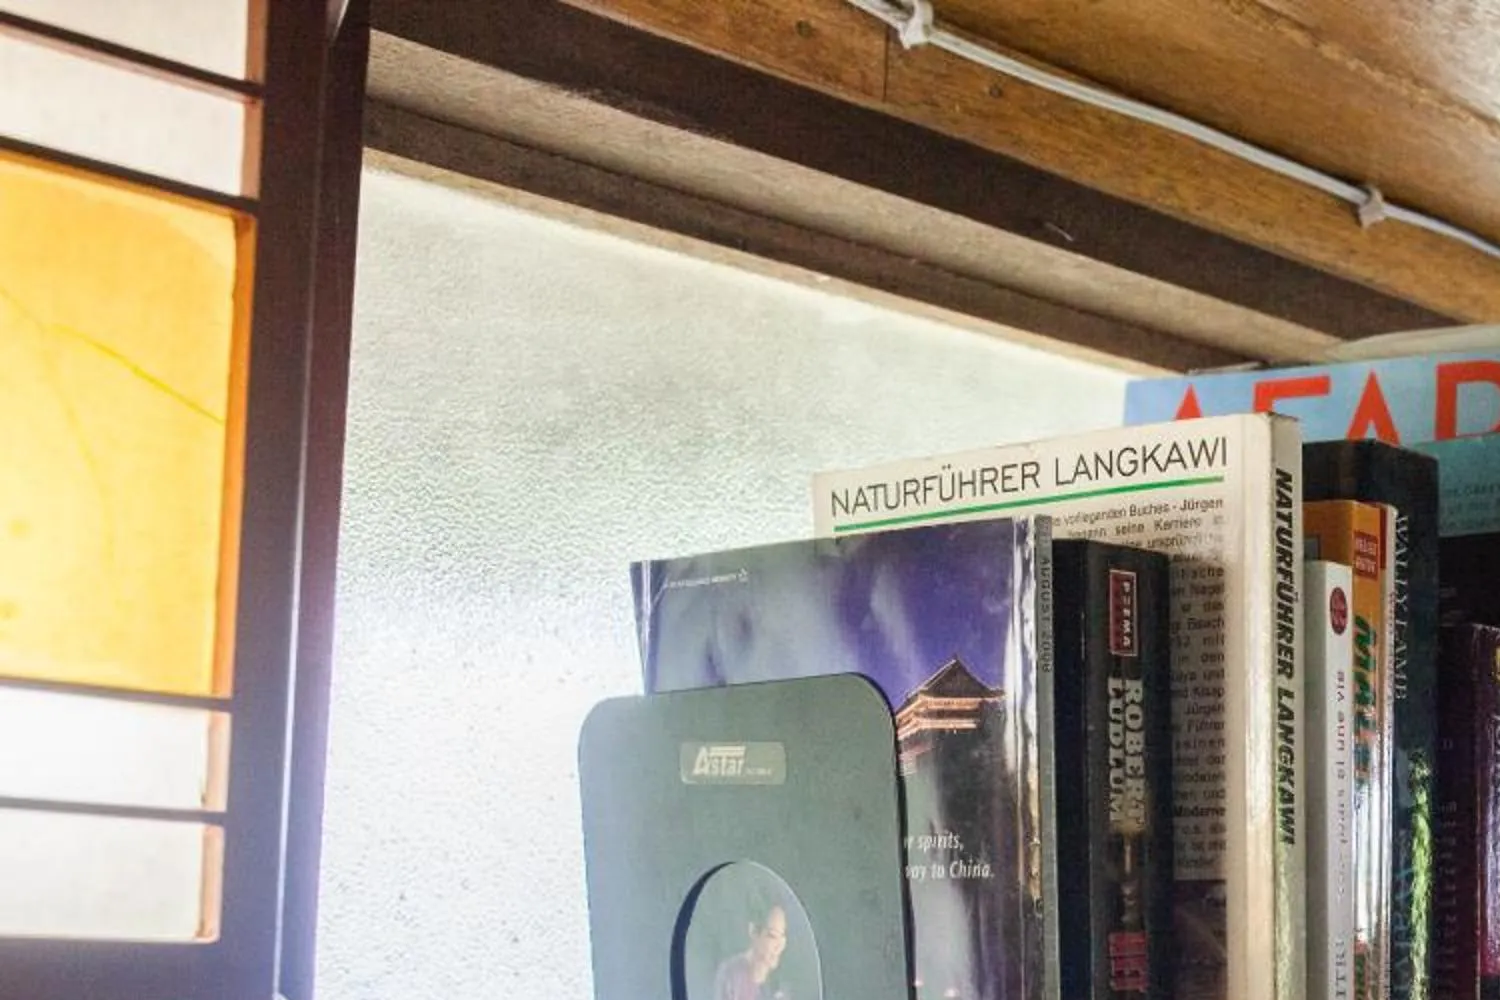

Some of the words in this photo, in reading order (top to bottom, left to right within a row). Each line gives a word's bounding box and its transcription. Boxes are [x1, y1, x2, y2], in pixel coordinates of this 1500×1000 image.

[831, 460, 1041, 518] NATURFÜHRER
[1055, 436, 1227, 487] LANGKAWI
[1129, 502, 1169, 518] Buches
[1179, 498, 1223, 514] Jürgen
[1039, 557, 1052, 624] AUGUST
[1276, 467, 1299, 681] NATURFÜHRER
[1395, 513, 1410, 613] WALLY
[1395, 617, 1410, 704] LAMB
[1107, 677, 1125, 822] LUDLUM
[1125, 678, 1148, 826] ROBERT
[1277, 685, 1297, 846] LANGKAWI
[949, 859, 995, 880] China.
